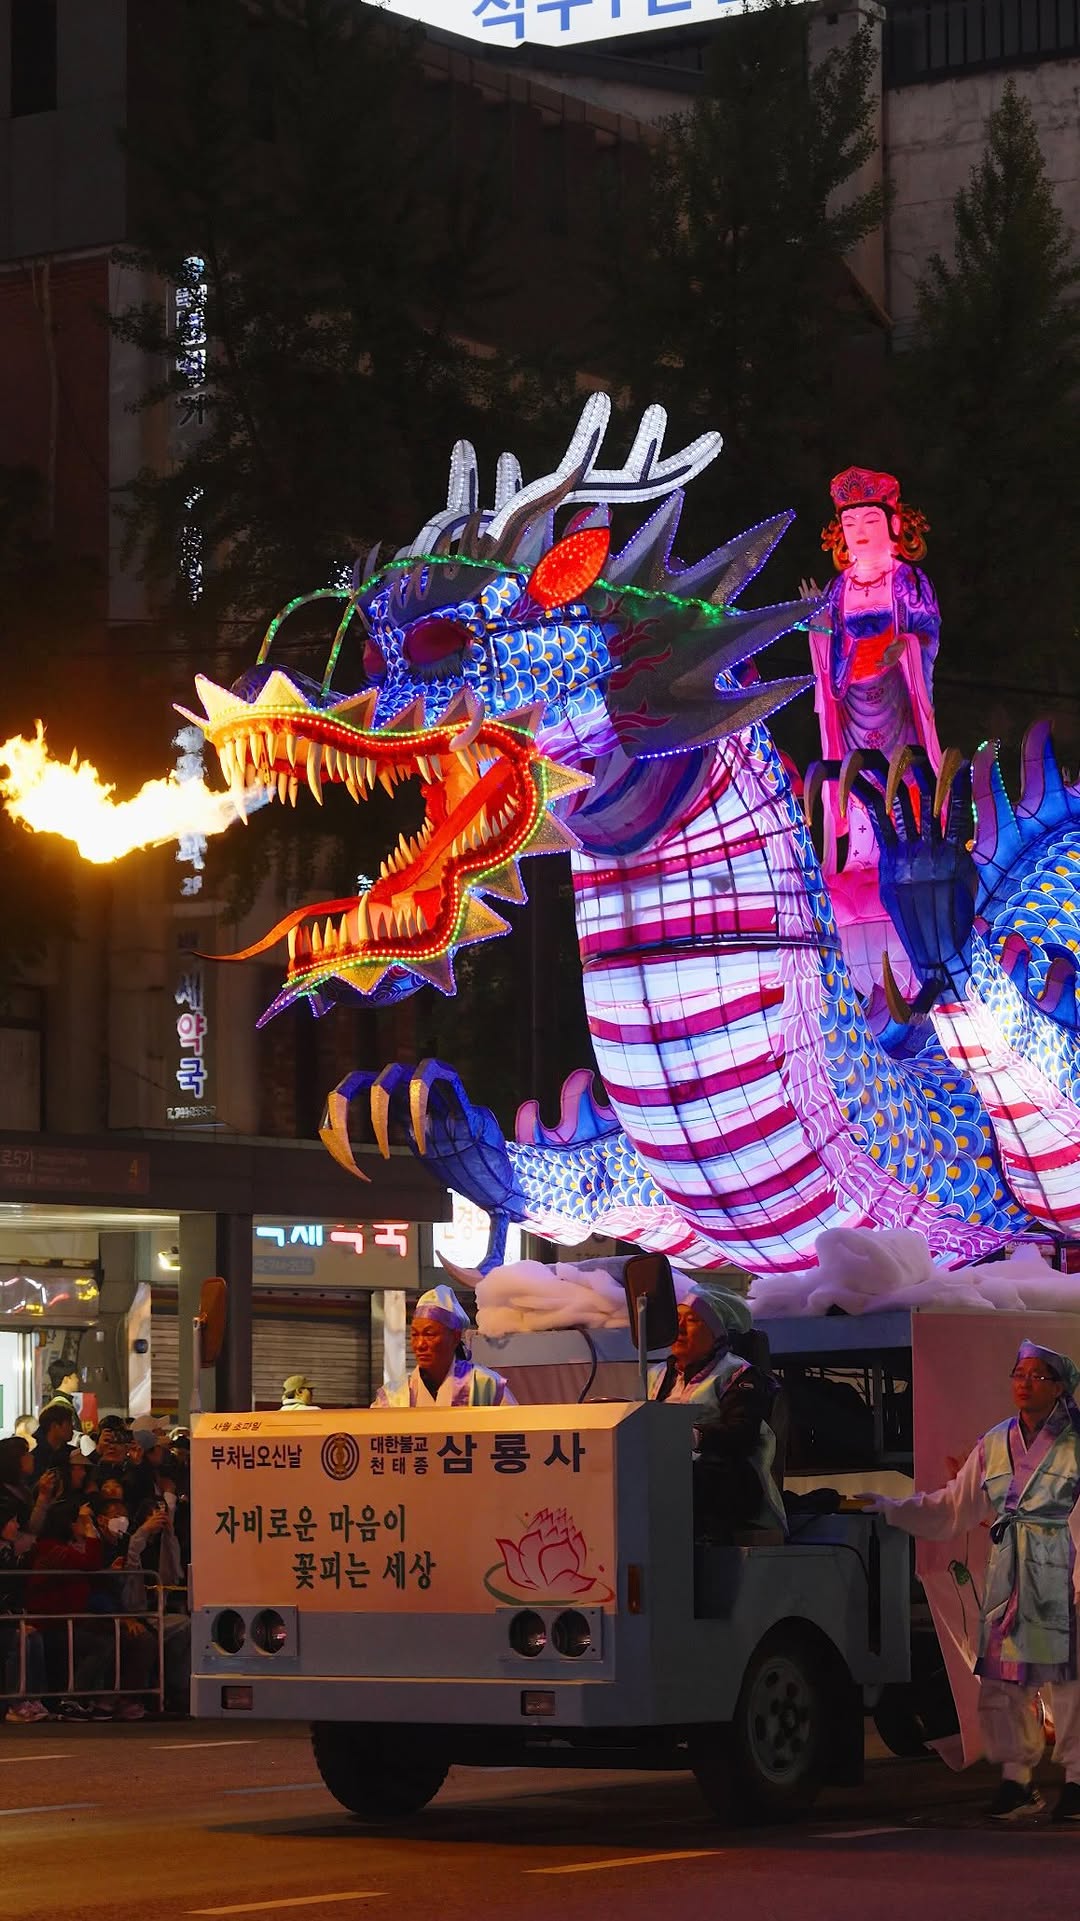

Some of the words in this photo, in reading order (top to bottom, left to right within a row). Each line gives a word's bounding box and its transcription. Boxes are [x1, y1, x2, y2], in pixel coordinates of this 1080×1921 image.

[211, 1421, 232, 1432] 사월
[232, 1420, 262, 1432] 초파일
[210, 1443, 302, 1471] 부처님오신날
[370, 1435, 429, 1454] 대한불교
[215, 1504, 318, 1544] 자비로운
[329, 1503, 406, 1544] 마음이
[291, 1550, 371, 1591] 꽃피는
[382, 1550, 437, 1591] 세상
